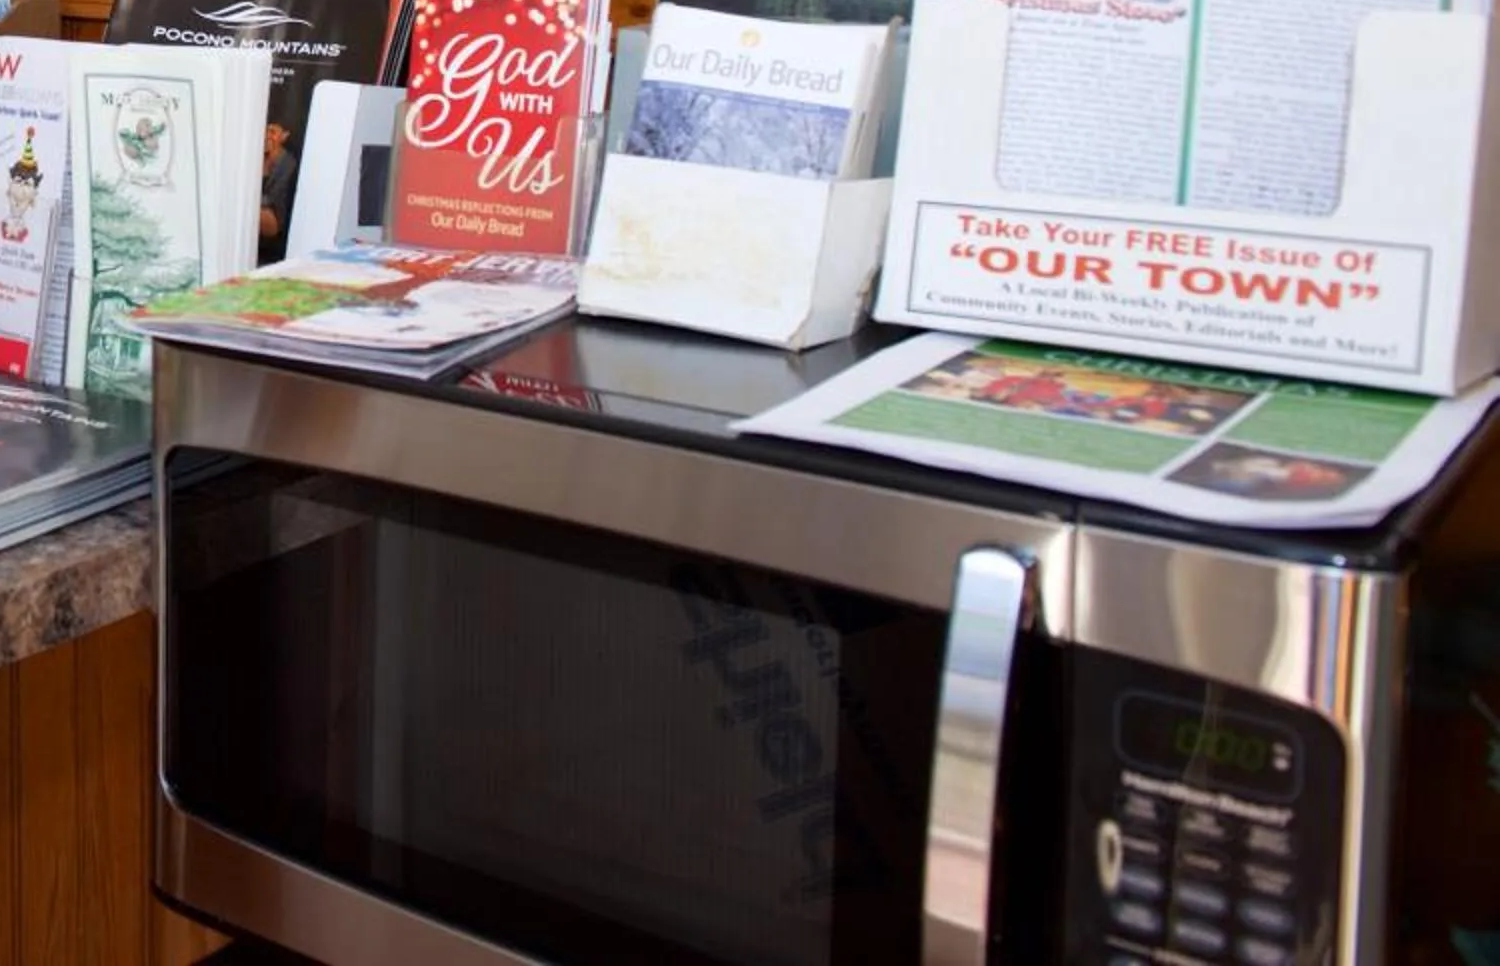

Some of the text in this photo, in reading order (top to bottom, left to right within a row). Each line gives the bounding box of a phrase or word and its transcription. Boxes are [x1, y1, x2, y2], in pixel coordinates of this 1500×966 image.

[153, 26, 342, 57] POCONO MOUNTAINS
[651, 43, 844, 94] Our Daily Bread
[404, 32, 578, 149] God
[500, 92, 554, 116] WITH
[467, 117, 565, 196] Us
[407, 193, 553, 220] CHRISTMAS REFLECTIONS FROM
[431, 212, 525, 237] Our Daily Bread
[957, 213, 1377, 273] Take Your FREE Issue Of
[926, 291, 1028, 314] Community
